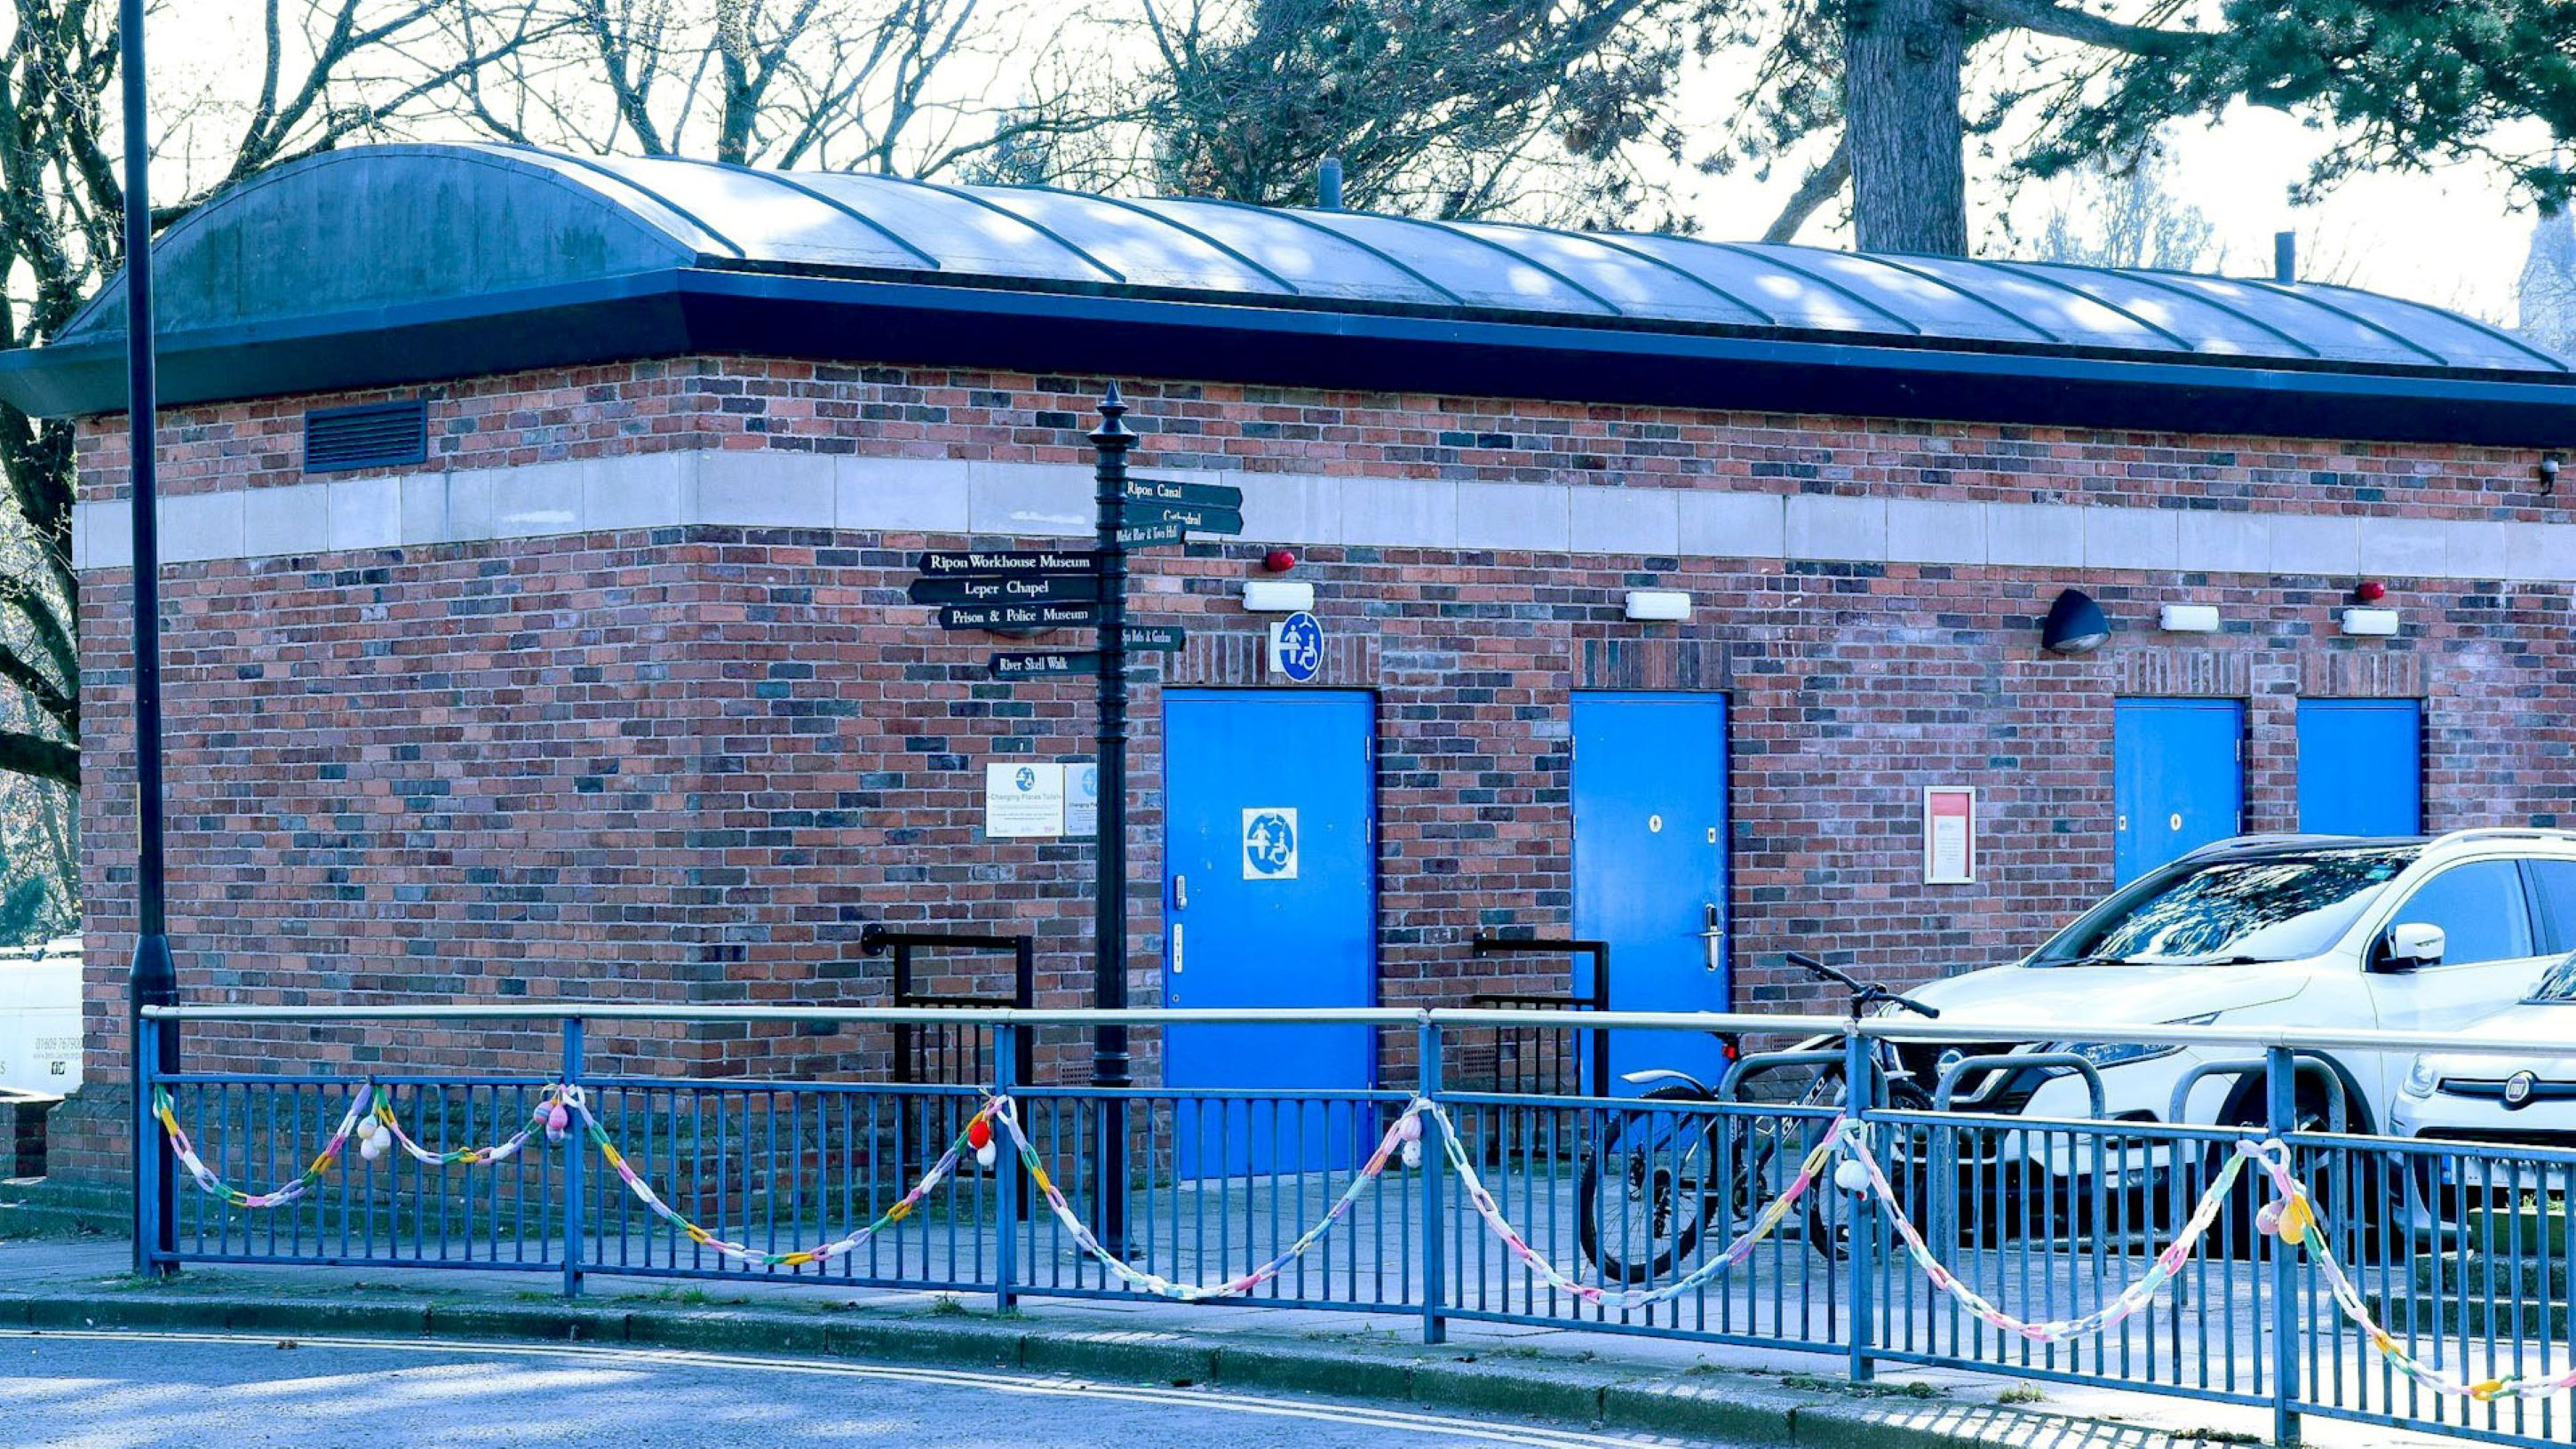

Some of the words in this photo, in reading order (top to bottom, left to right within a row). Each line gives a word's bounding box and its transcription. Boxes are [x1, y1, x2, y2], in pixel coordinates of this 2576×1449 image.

[1127, 481, 1153, 498] Ripon
[1157, 483, 1182, 498] Canal
[930, 554, 968, 572] Ripon
[969, 554, 1037, 569] Workhouse
[1039, 554, 1091, 569] Museum
[965, 582, 1000, 599] Leper
[1006, 580, 1050, 598] Chapel
[952, 609, 984, 625] Prison
[989, 609, 1000, 622] &
[1006, 609, 1037, 622] Police
[1043, 608, 1089, 622] Museum
[999, 657, 1022, 672] River
[1024, 656, 1046, 671] Skell
[1046, 656, 1069, 670] Walk
